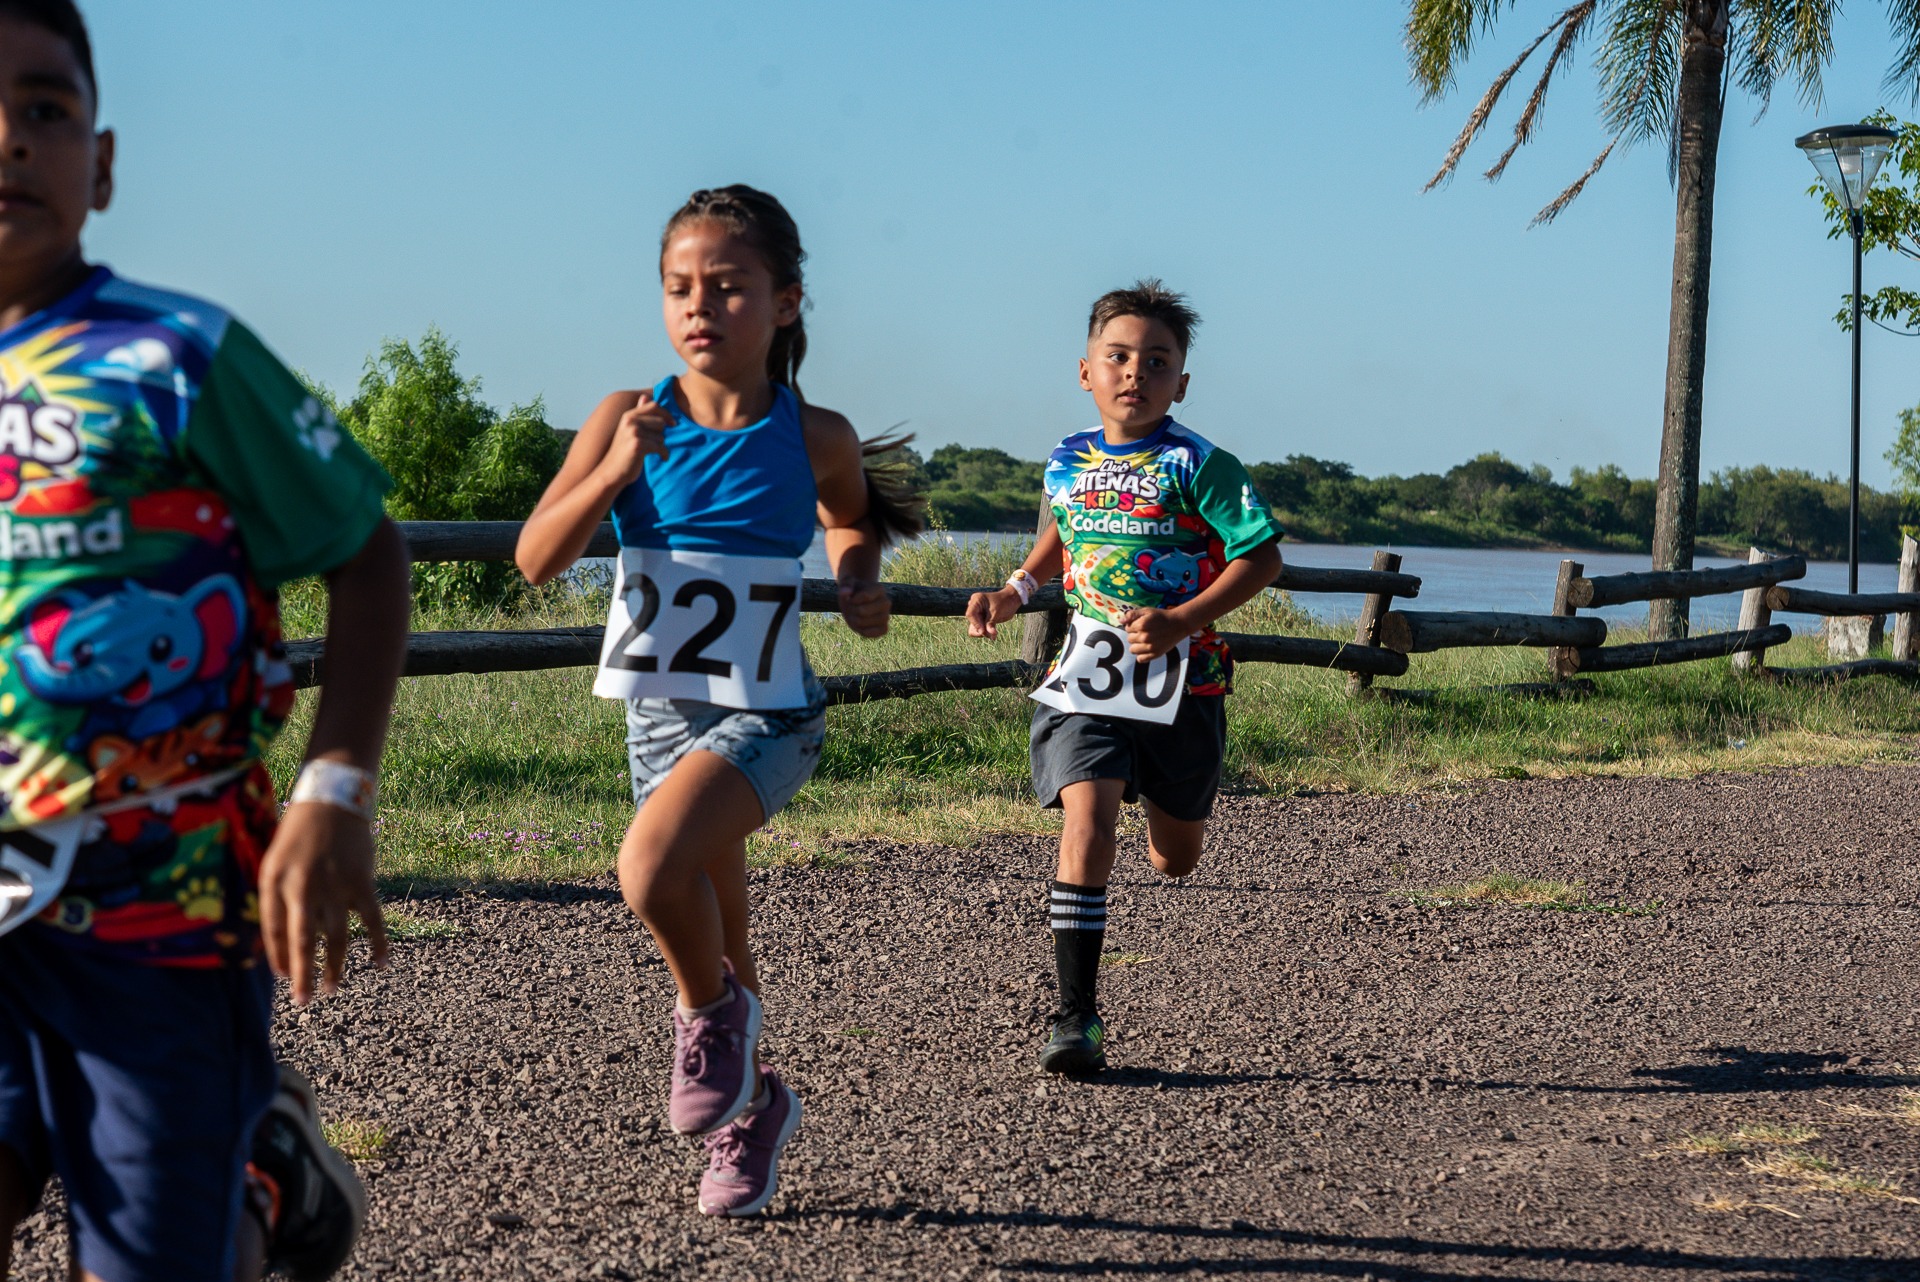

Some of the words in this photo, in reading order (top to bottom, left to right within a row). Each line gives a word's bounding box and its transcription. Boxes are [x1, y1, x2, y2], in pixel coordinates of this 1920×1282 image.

[1100, 459, 1130, 473] Club
[1070, 471, 1160, 498] ATENAS
[1071, 514, 1174, 535] Codeland
[606, 573, 796, 682] 227
